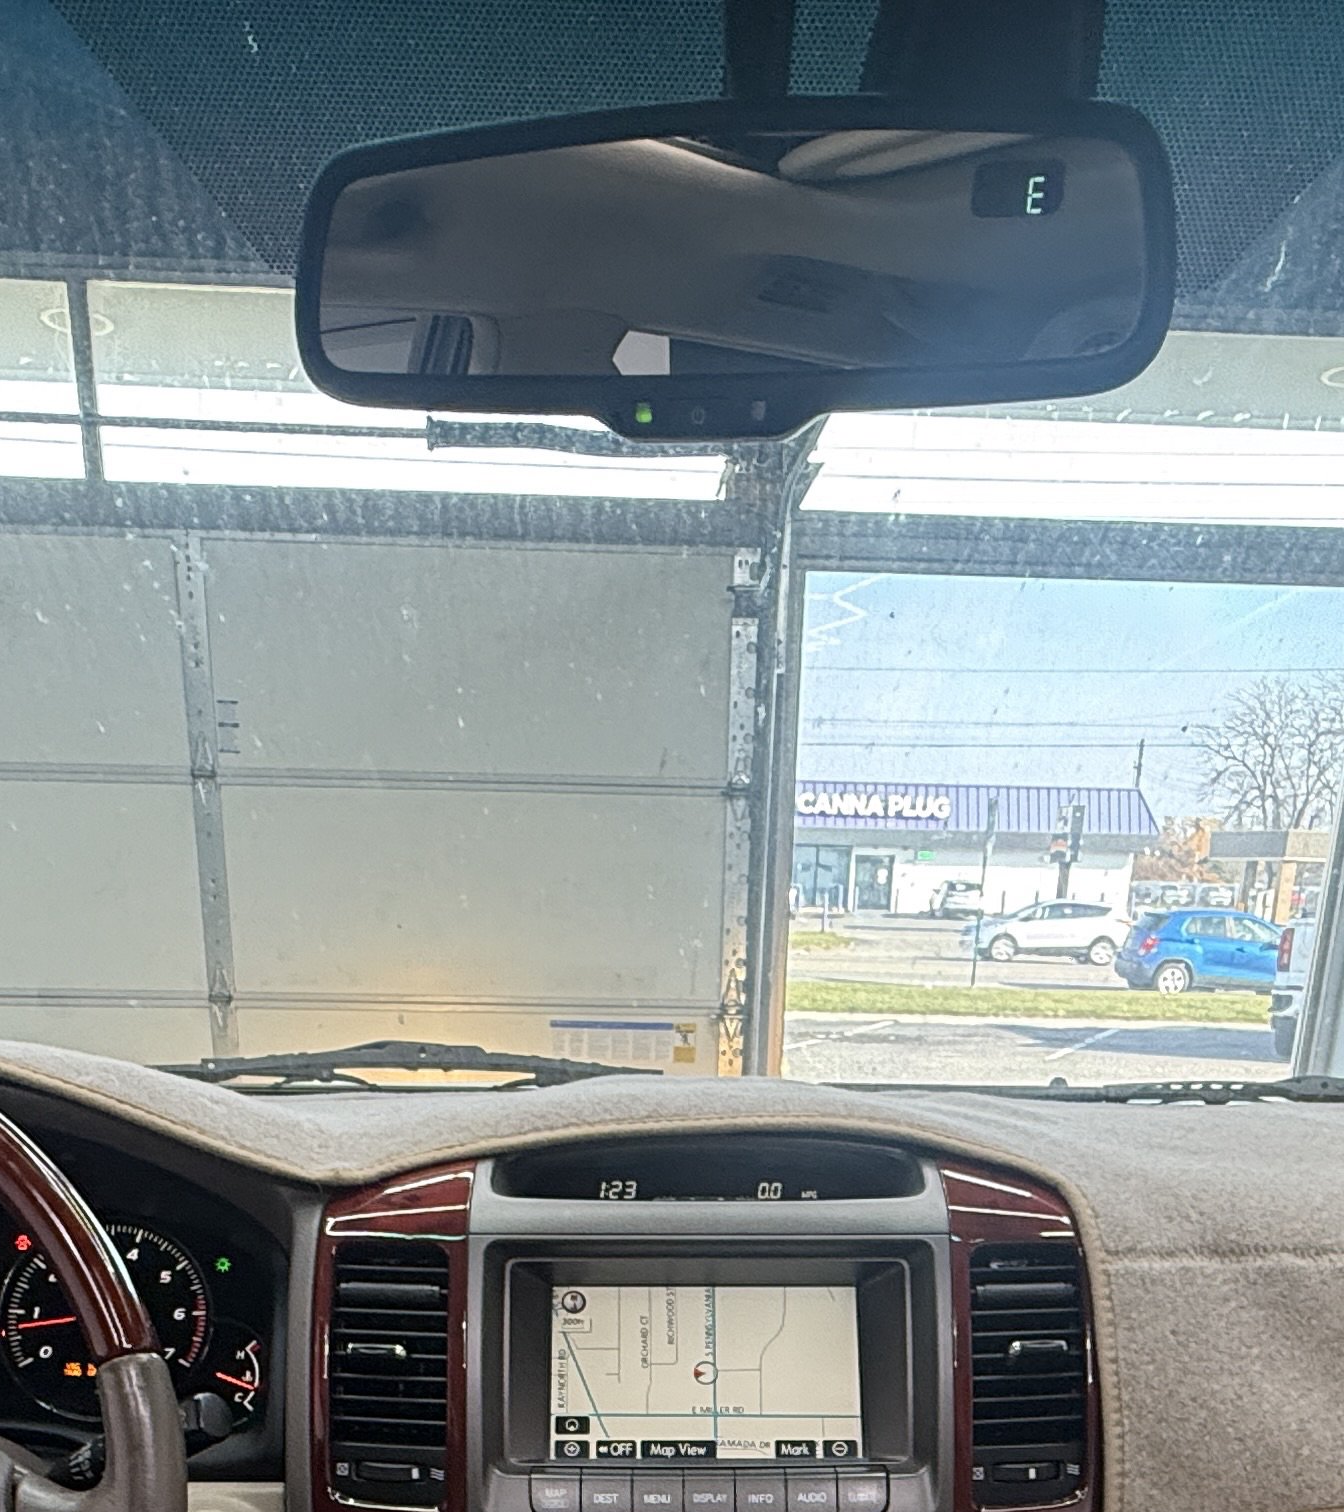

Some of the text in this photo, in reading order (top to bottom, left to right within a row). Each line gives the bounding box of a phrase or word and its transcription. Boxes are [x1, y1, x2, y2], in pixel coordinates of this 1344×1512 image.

[1027, 176, 1045, 214] E
[796, 792, 951, 819] CANNA PLUG
[599, 1180, 638, 1199] 1:23
[126, 1249, 139, 1261] 4
[160, 1271, 172, 1283] 5
[32, 1307, 41, 1318] 1
[173, 1308, 185, 1320] 6
[666, 1298, 675, 1345] RICHWOOD
[39, 1346, 53, 1358] 0
[640, 1324, 650, 1369] ORCHARD
[164, 1347, 175, 1359] 7
[235, 1391, 244, 1402] C
[610, 1443, 633, 1456] OFF
[716, 1439, 757, 1449] AMADA
[781, 1443, 810, 1456] Mark
[649, 1443, 707, 1458] Map View
[593, 1493, 619, 1504] DEST
[643, 1494, 671, 1504] MENU
[692, 1493, 727, 1503] DISPLAY
[748, 1494, 774, 1504] INFO
[797, 1492, 827, 1503] AUDIO
